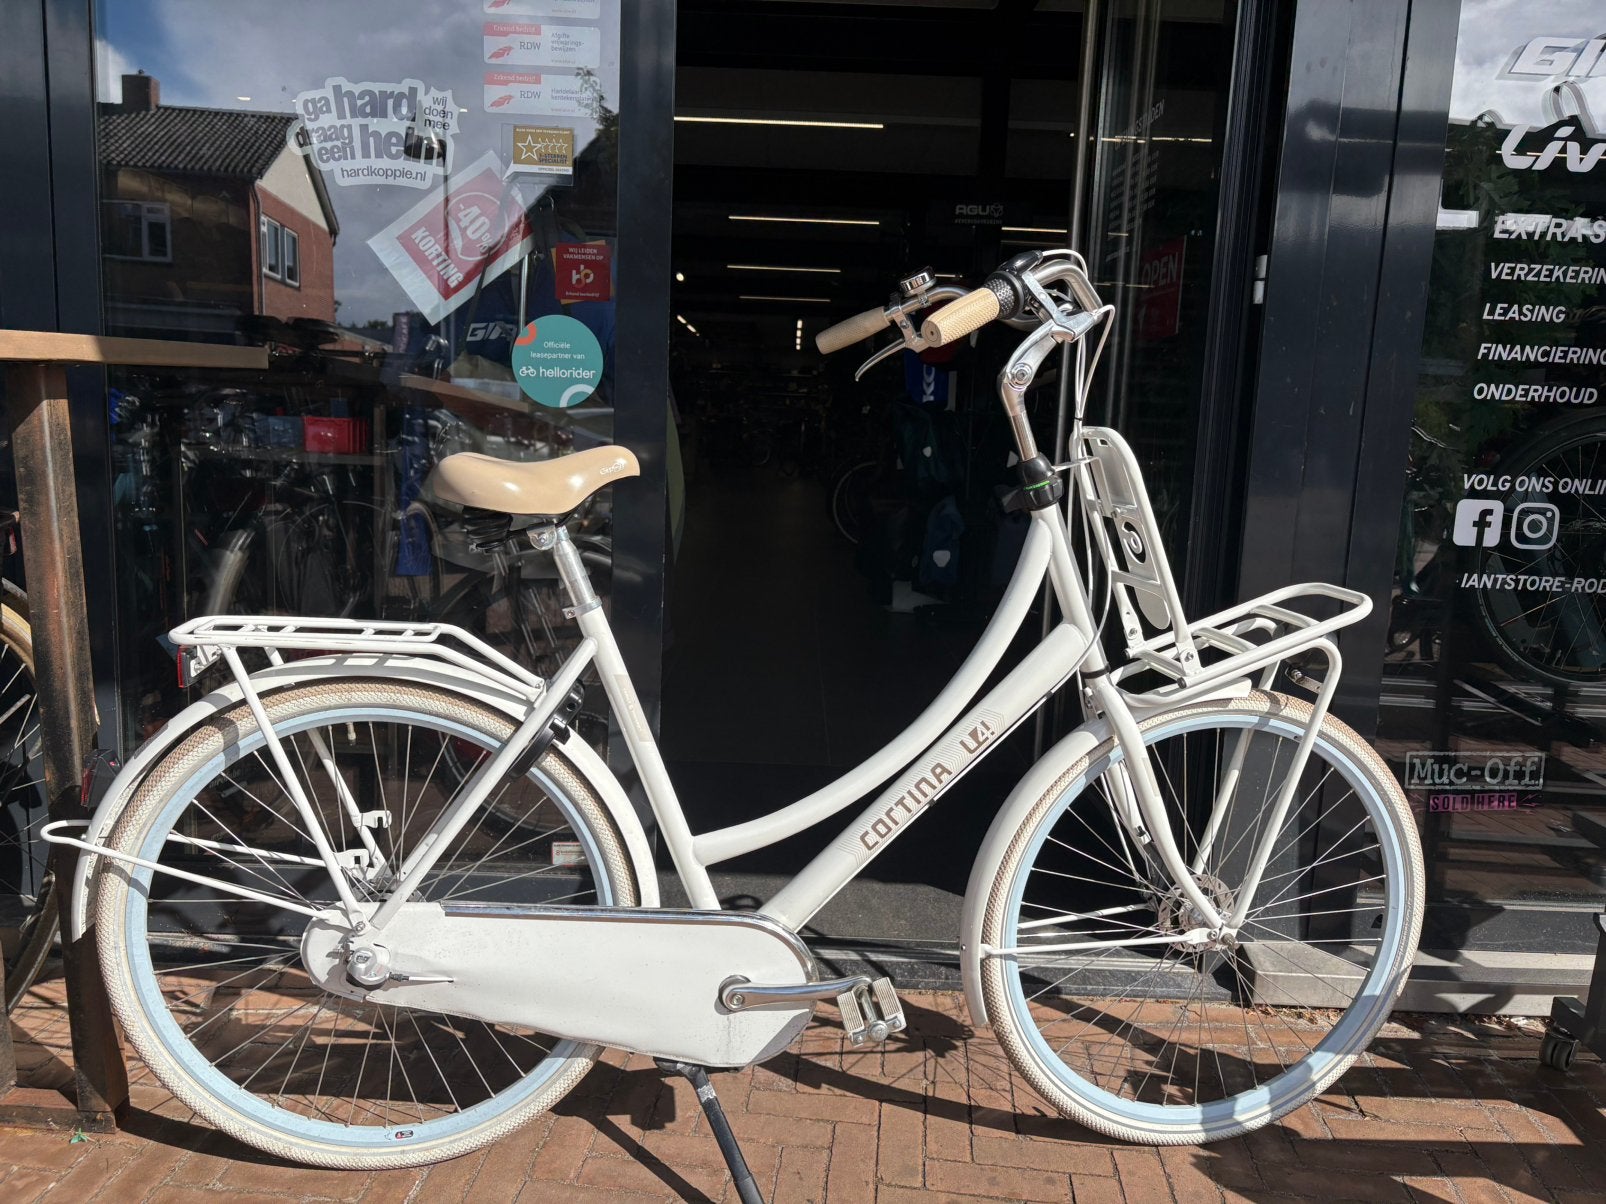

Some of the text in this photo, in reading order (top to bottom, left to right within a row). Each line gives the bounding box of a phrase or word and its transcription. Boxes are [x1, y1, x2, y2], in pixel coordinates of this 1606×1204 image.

[519, 41, 541, 51] RDW
[303, 84, 418, 122] ga hard
[432, 96, 448, 109] wij
[519, 90, 541, 99] RDW
[423, 106, 453, 120] doen
[424, 118, 450, 130] mee
[295, 124, 354, 149] draag
[317, 142, 357, 164] een
[340, 166, 427, 182] hardkoppie.nl
[955, 204, 990, 216] AGU
[411, 226, 464, 289] KORTING
[562, 253, 596, 261] VAKMENSEN
[1141, 252, 1178, 289] OPEN
[1482, 303, 1566, 323] LEASING
[543, 341, 571, 350] Officiële
[530, 351, 585, 361] leasepartner van
[539, 366, 596, 379] hellorider
[1473, 382, 1598, 405] ONDERHOUD
[1463, 473, 1512, 491] VOLG
[1515, 475, 1555, 493] ONS
[1410, 756, 1539, 786] Muc-Off
[859, 762, 953, 851] CORTINA
[1431, 793, 1516, 812] SOLD HERE
